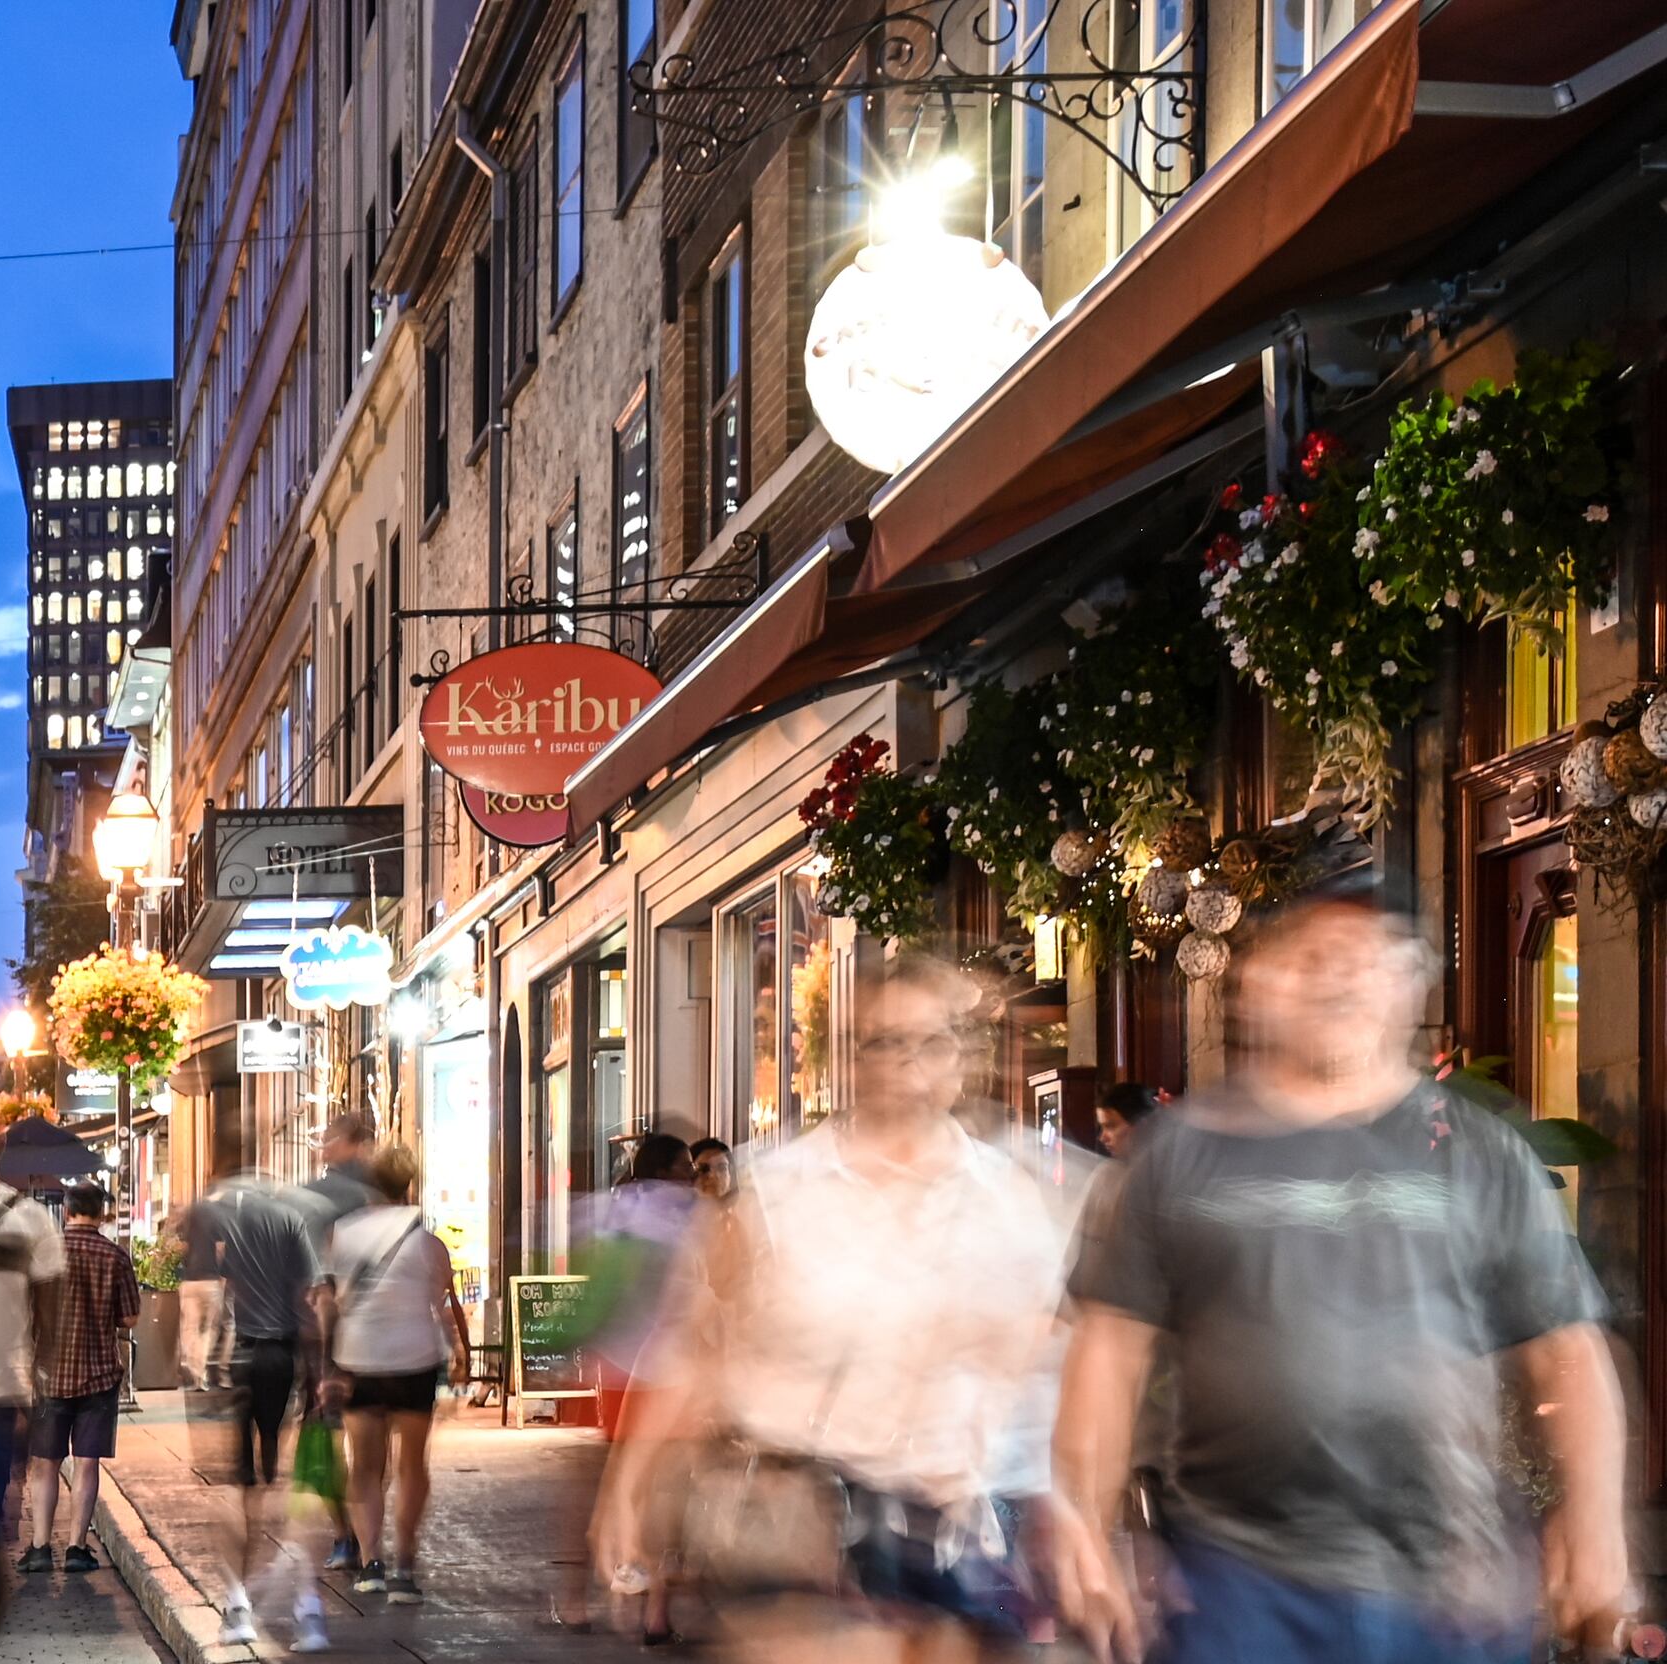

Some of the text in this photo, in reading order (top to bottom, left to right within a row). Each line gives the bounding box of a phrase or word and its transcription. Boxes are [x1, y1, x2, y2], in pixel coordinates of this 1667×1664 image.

[446, 678, 641, 737] Karibu
[446, 741, 605, 756] VINS DU QUÉBEC ESPACE GO
